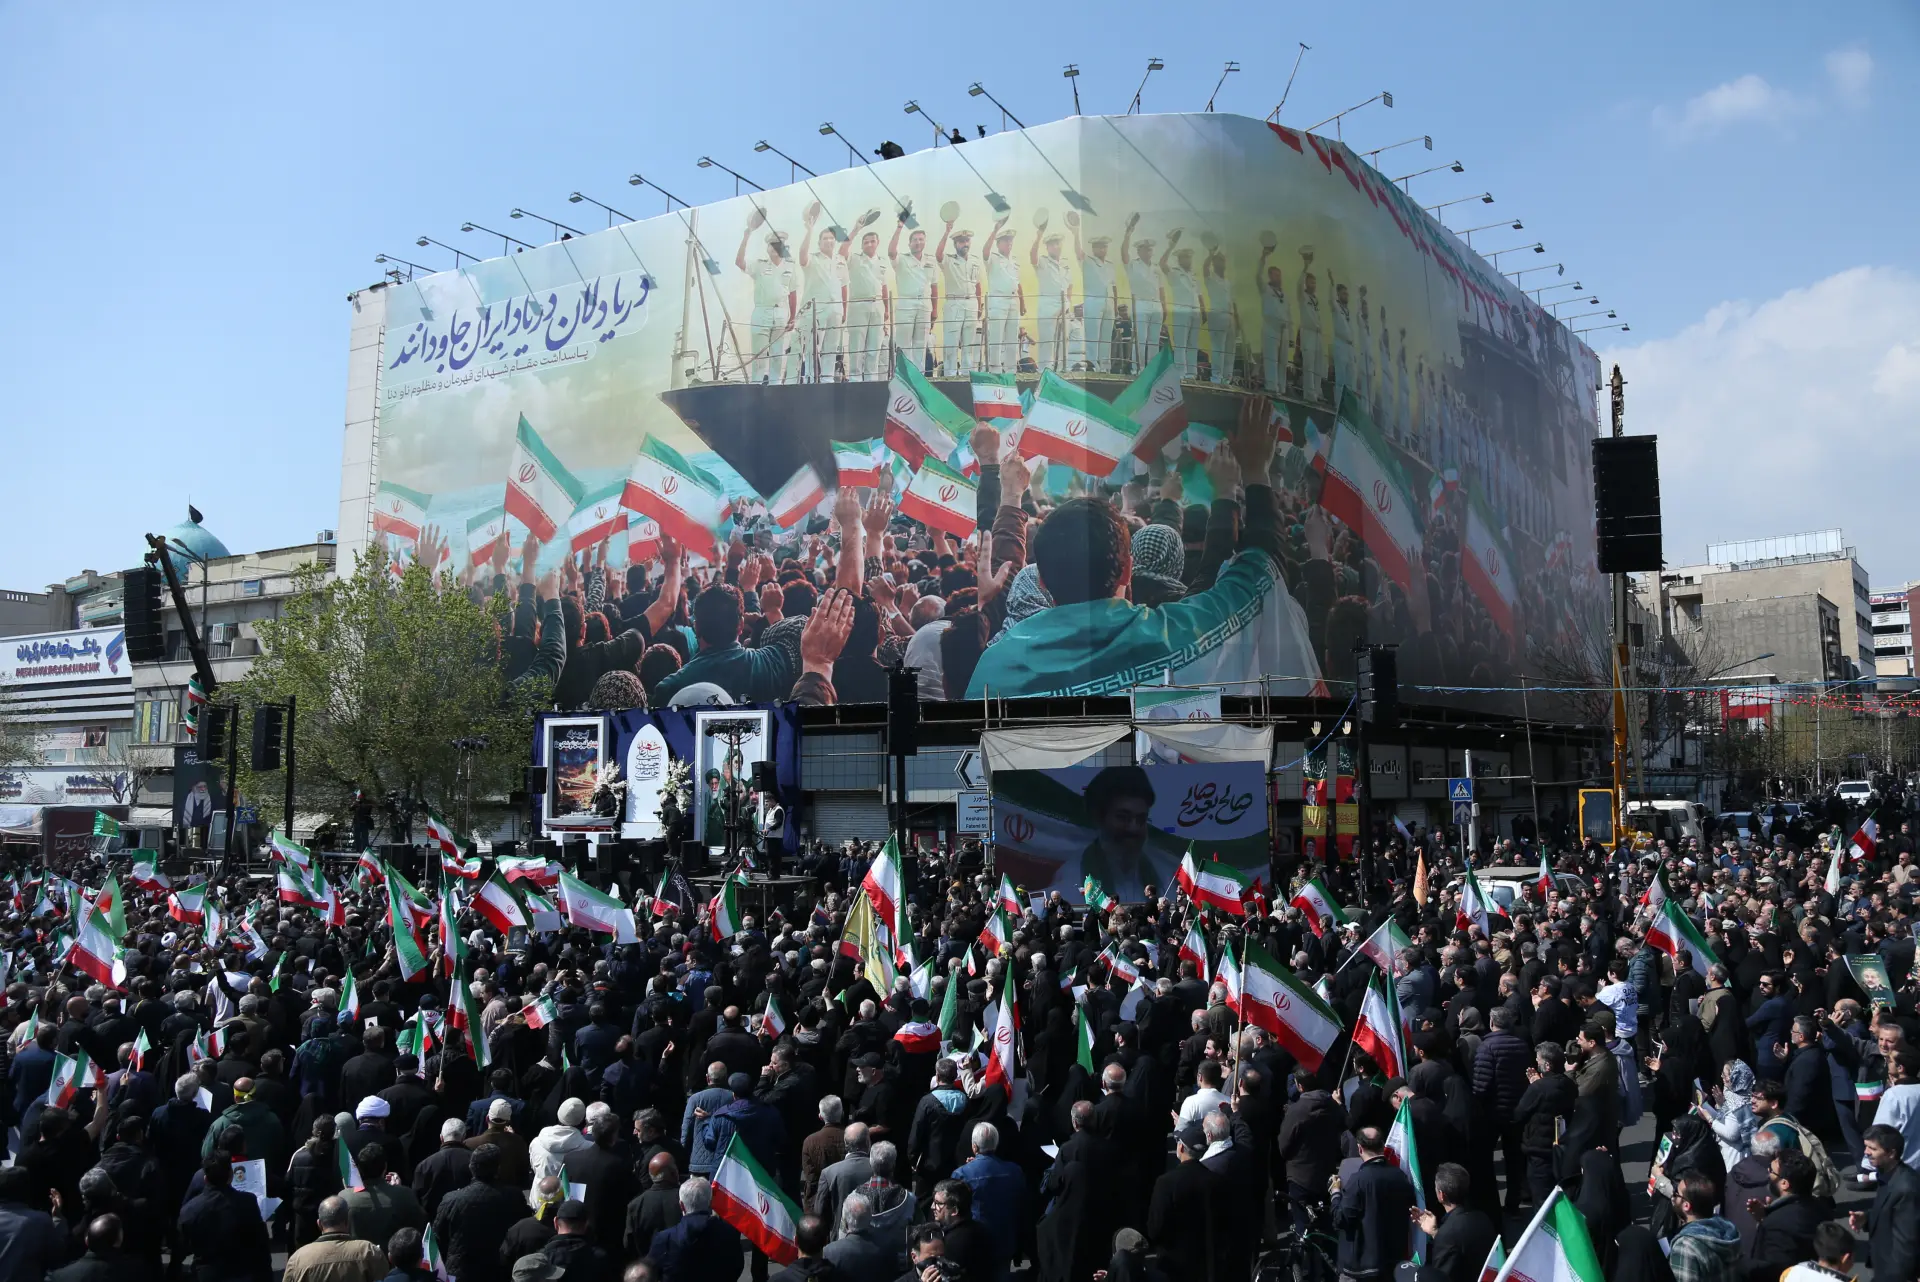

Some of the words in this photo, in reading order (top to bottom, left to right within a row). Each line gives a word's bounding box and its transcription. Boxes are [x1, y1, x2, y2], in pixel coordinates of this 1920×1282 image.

[540, 346, 589, 366] پاسداشت
[474, 364, 509, 382] شهدای
[509, 359, 538, 377] مقام
[410, 379, 437, 397] مظلوم
[444, 370, 474, 389] قهرمان
[17, 640, 50, 664] کارگران
[49, 638, 75, 660] رفاه
[74, 637, 102, 660] بانک
[1383, 760, 1402, 780] بانک
[1215, 783, 1253, 825] صالح
